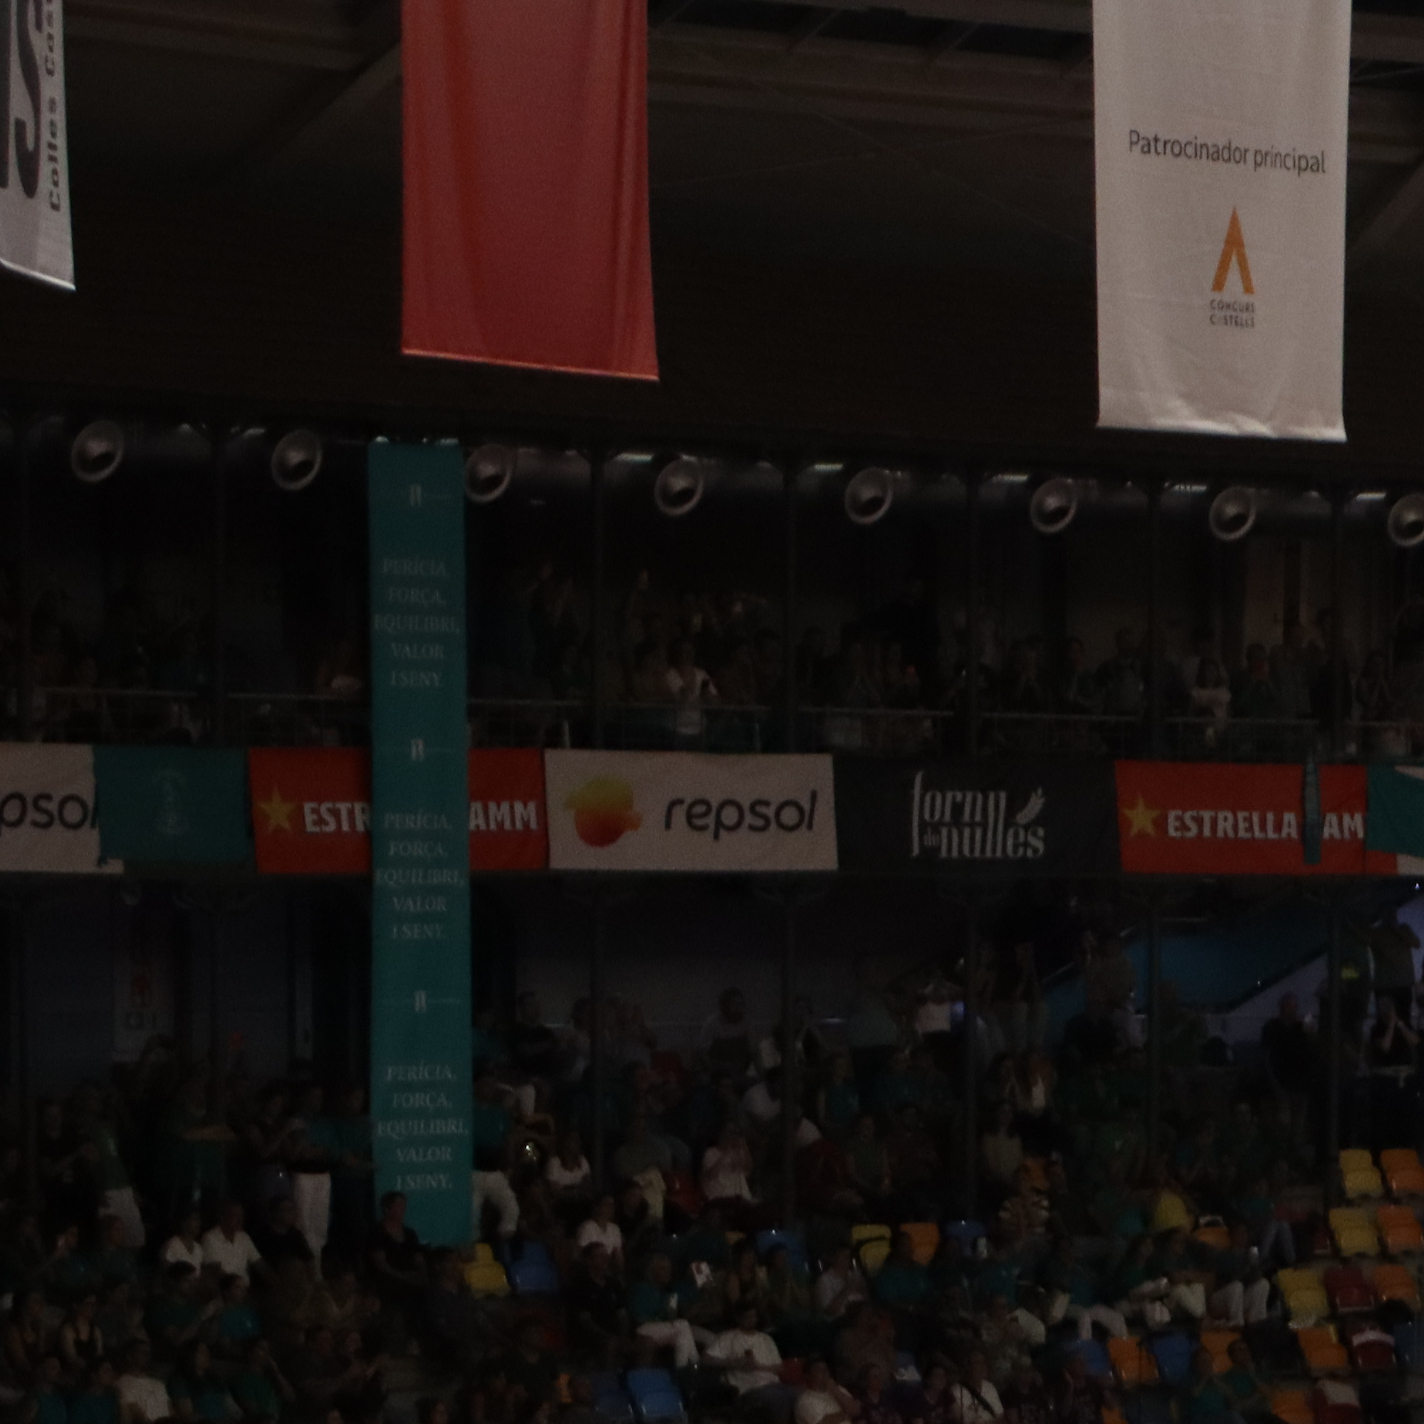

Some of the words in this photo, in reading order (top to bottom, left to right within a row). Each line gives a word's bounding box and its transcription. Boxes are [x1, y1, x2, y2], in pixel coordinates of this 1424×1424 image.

[44, 0, 55, 77] Cas
[1127, 129, 1249, 166] Patrocinador
[1253, 144, 1327, 176] principal
[1209, 299, 1256, 314] CONCURS
[391, 643, 445, 660] VALOR
[469, 801, 538, 831] AMM
[664, 790, 817, 841] repsol
[1167, 810, 1299, 840] ESTRELLA
[1322, 814, 1365, 841] AM
[392, 896, 447, 913] VALOR
[396, 1146, 452, 1163] VALOR
